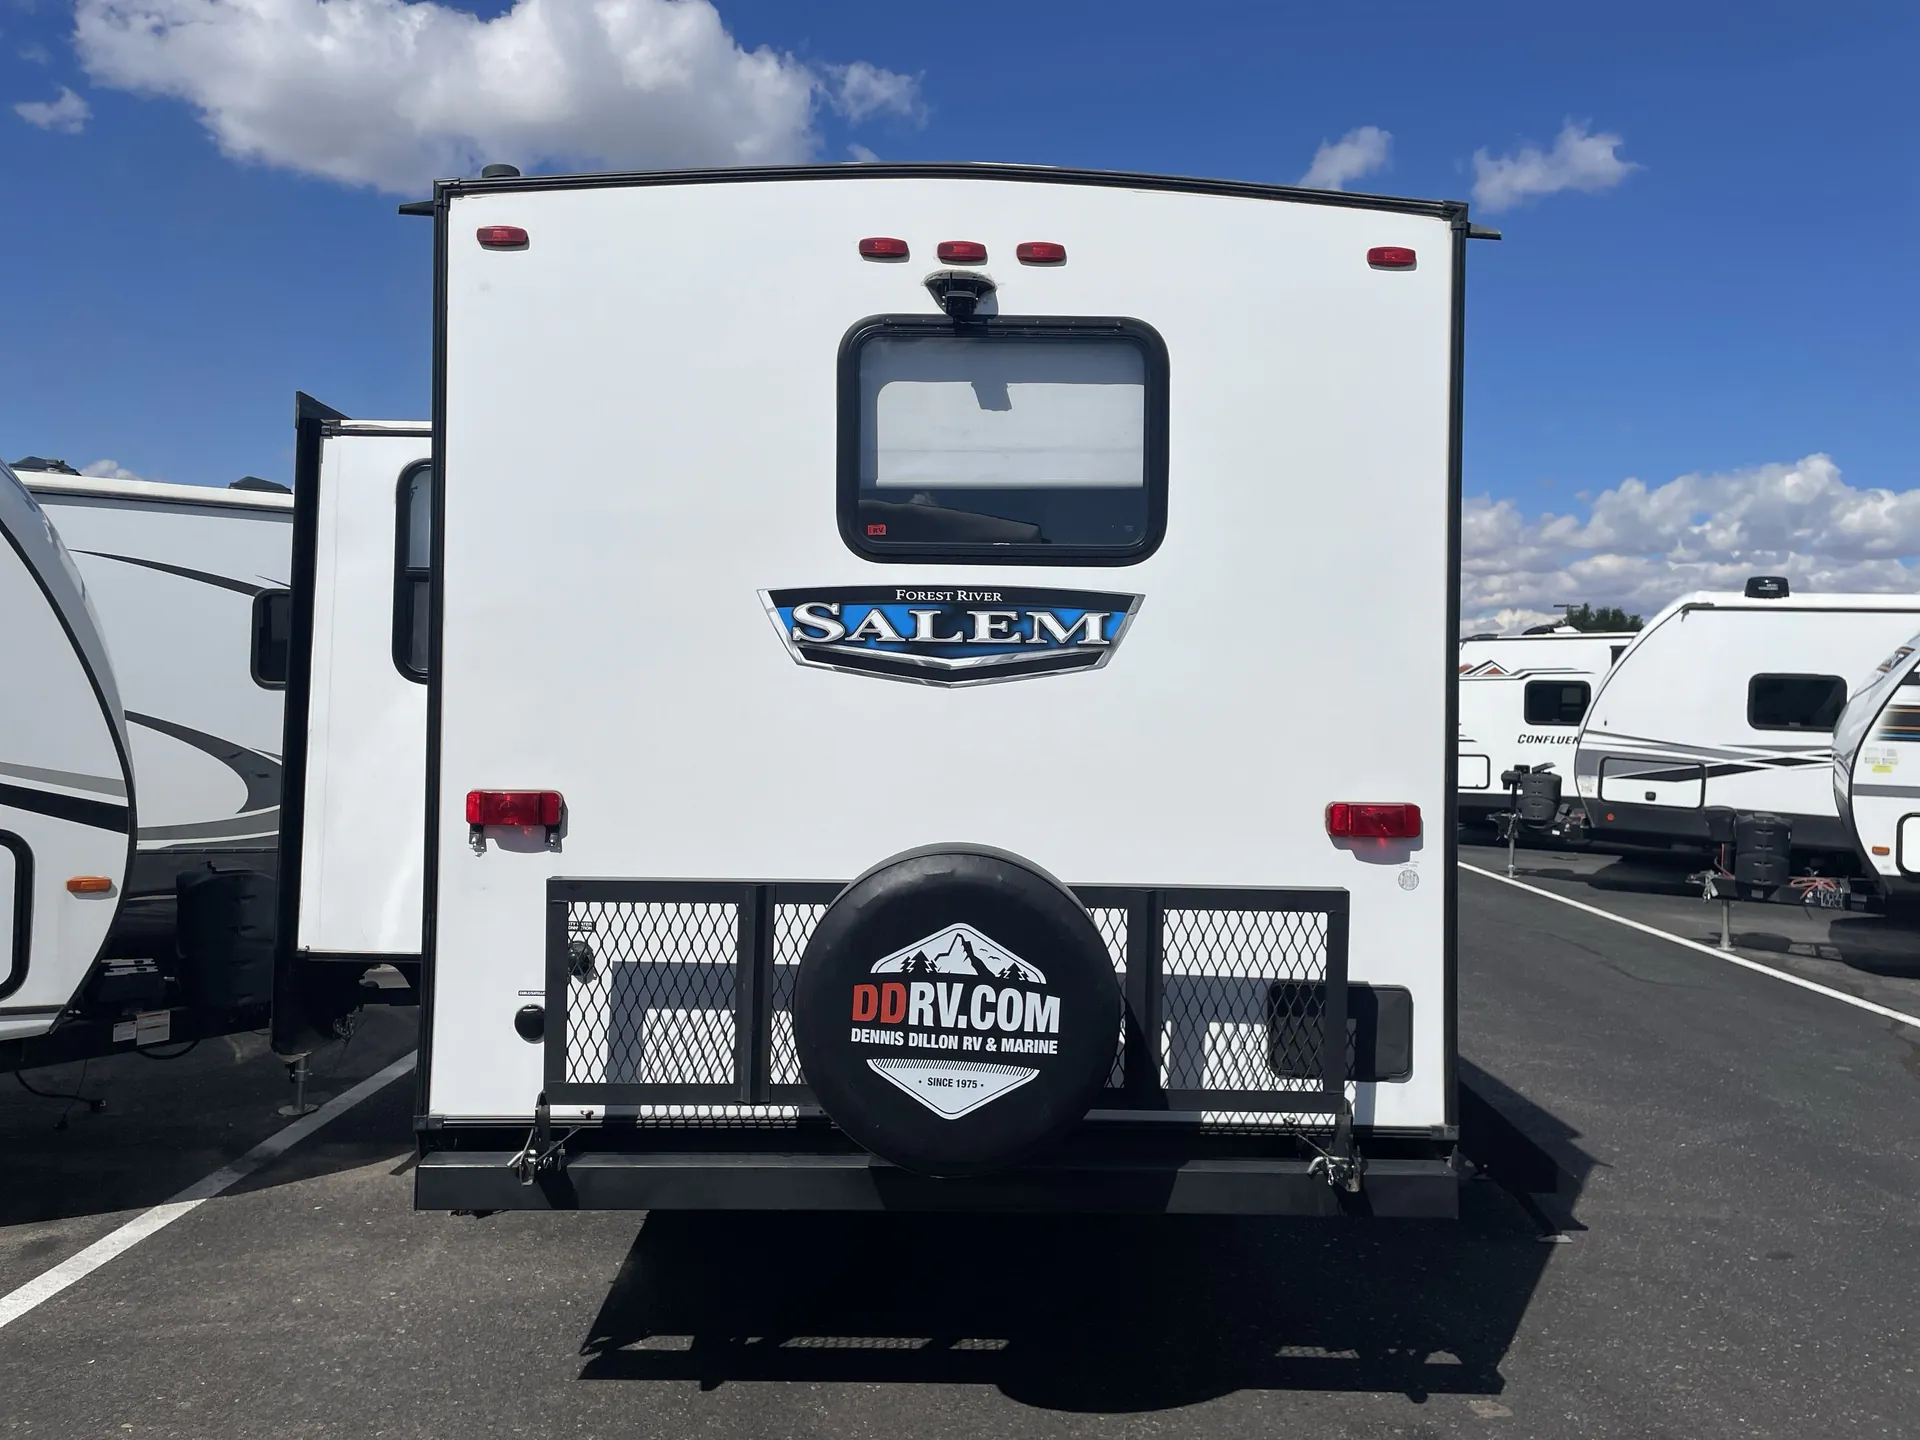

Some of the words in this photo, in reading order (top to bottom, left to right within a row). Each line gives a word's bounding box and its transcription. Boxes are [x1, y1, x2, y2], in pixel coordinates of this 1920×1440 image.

[895, 588, 954, 601] FOREST
[957, 589, 1003, 602] RIVER
[791, 602, 1111, 645] SALEM
[1517, 733, 1580, 745] CONFLUEN
[851, 981, 1061, 1034] DDRV.COM
[850, 1027, 904, 1046] DENNIS
[908, 1032, 959, 1050] DILLON
[962, 1036, 982, 1051] RV
[985, 1037, 997, 1052] &
[1001, 1038, 1058, 1055] MARINE
[927, 1077, 953, 1088] SINCE
[956, 1078, 978, 1089] 1975
